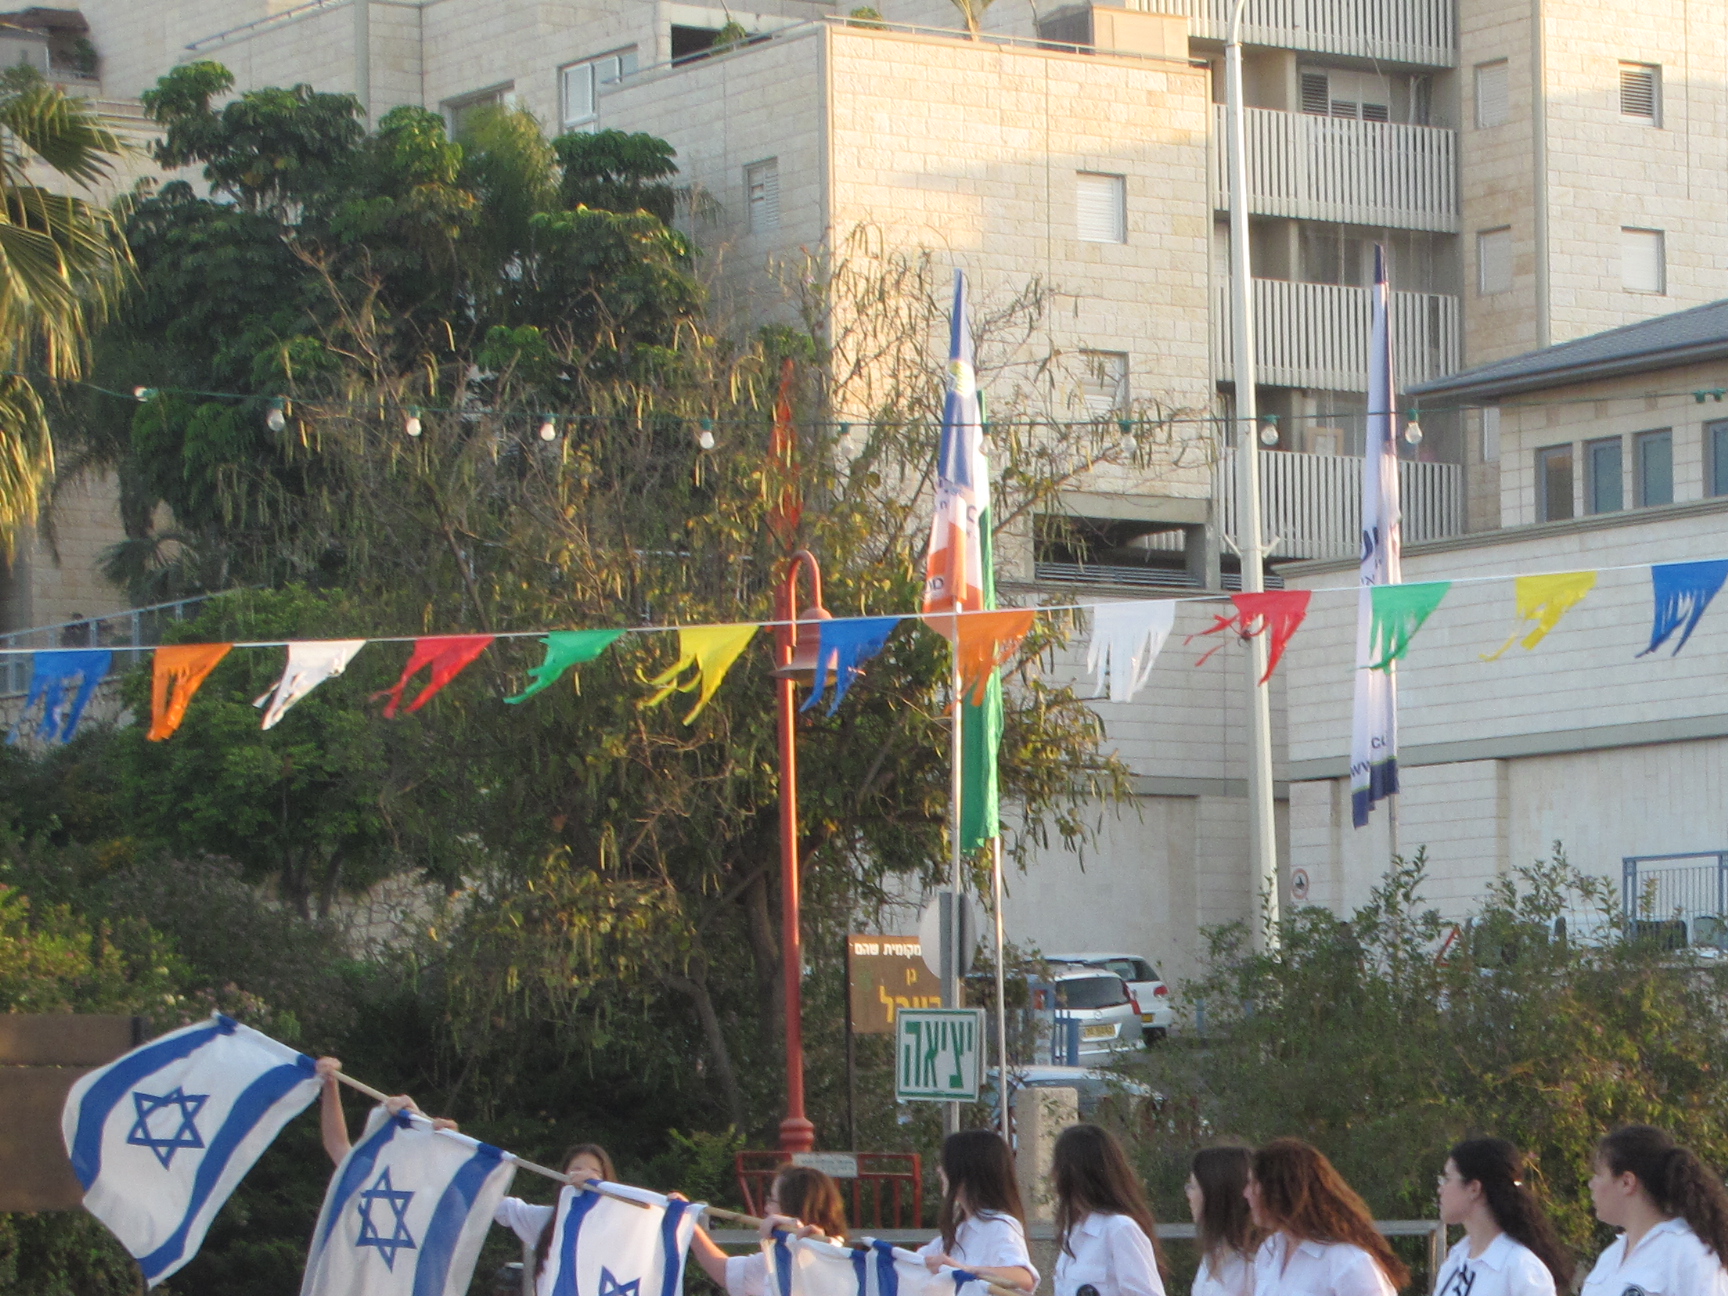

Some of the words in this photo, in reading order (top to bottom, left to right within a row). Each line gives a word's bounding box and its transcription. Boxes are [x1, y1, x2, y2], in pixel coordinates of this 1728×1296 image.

[854, 942, 880, 956] שהם
[883, 942, 922, 959] מקומית
[905, 968, 917, 986] גן
[904, 1021, 973, 1089] יציאה
